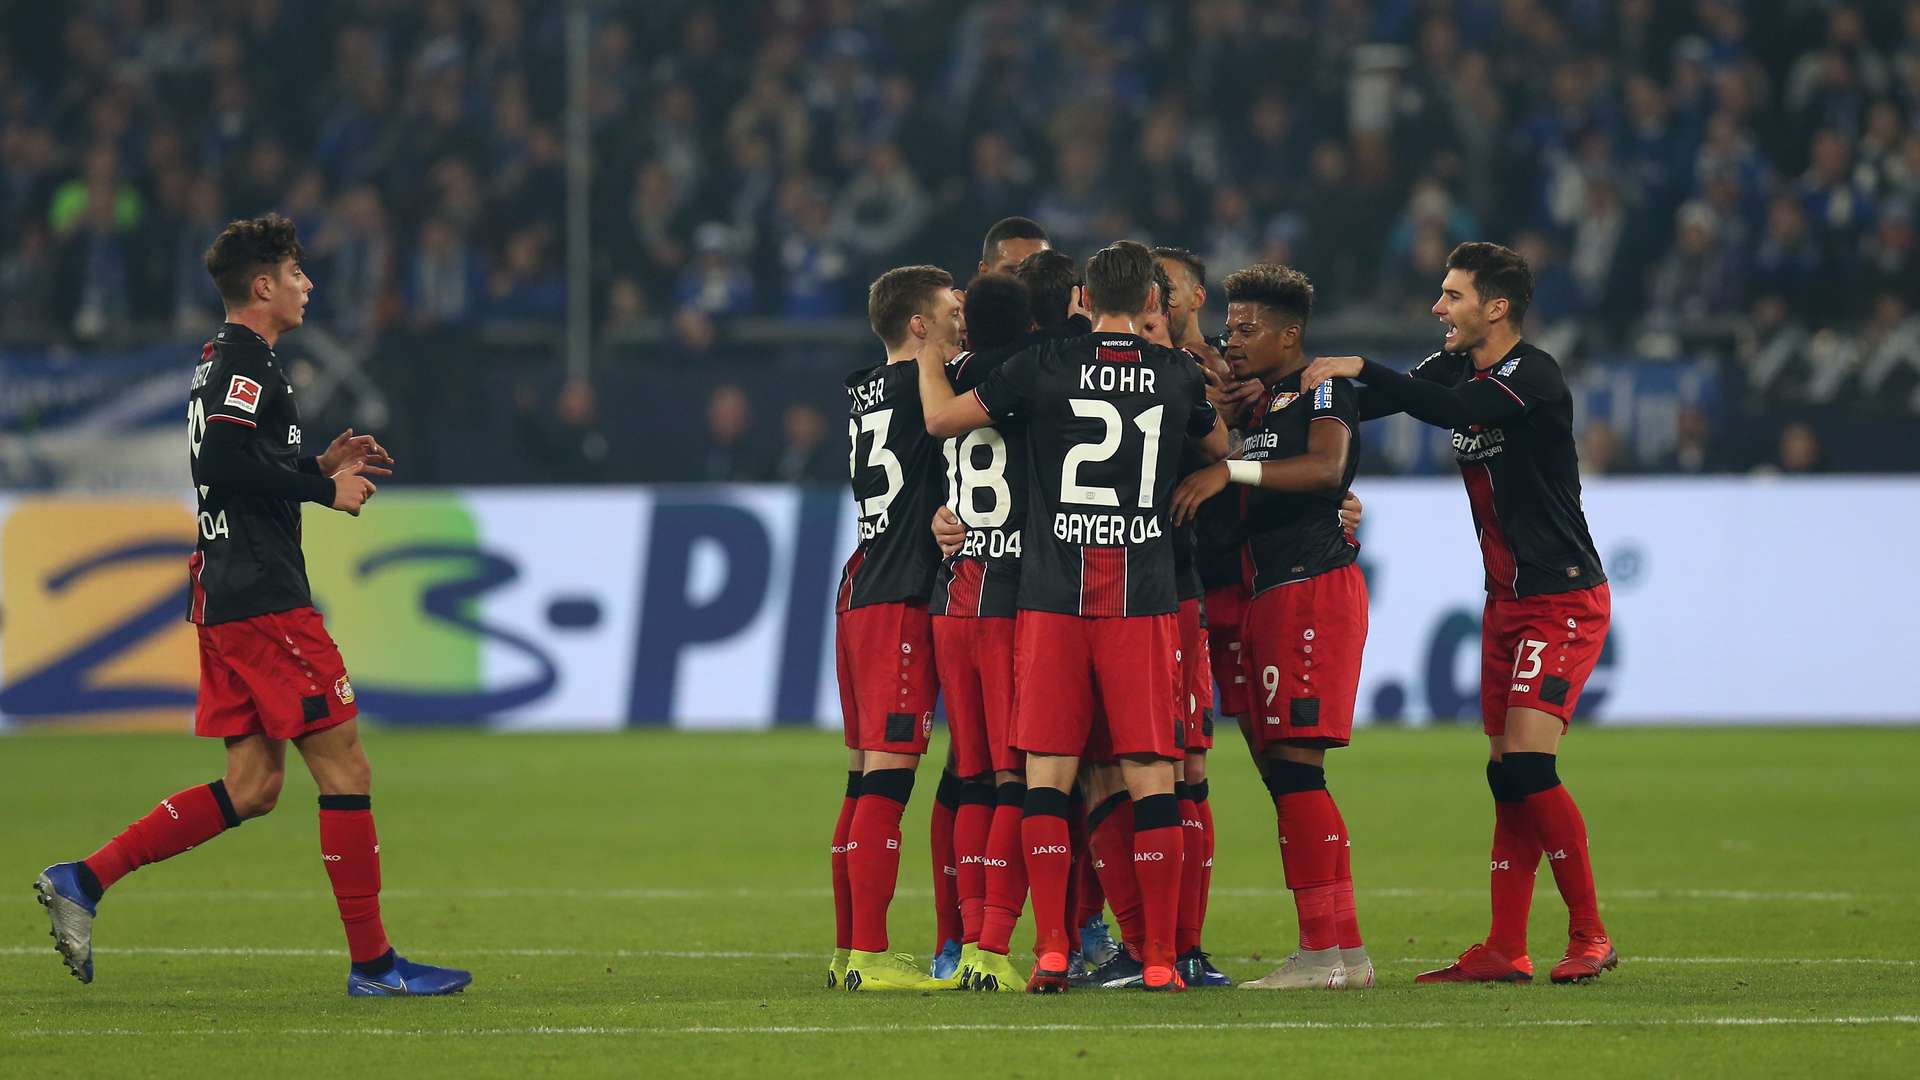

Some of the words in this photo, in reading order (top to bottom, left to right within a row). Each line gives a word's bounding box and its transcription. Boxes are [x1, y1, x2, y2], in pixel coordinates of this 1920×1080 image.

[1080, 364, 1155, 394] KOHR
[1323, 379, 1333, 409] ESER
[287, 424, 302, 445] Ba
[1060, 398, 1164, 508] 21
[943, 427, 1012, 528] 18
[200, 509, 229, 541] 04
[1054, 513, 1125, 545] BAYER
[1130, 514, 1162, 544] 04
[957, 530, 986, 557] ER
[989, 529, 1022, 558] 04
[1512, 638, 1549, 679] 13
[1262, 665, 1280, 707] 9
[161, 799, 179, 820] AKO
[1031, 845, 1067, 855] JAKO
